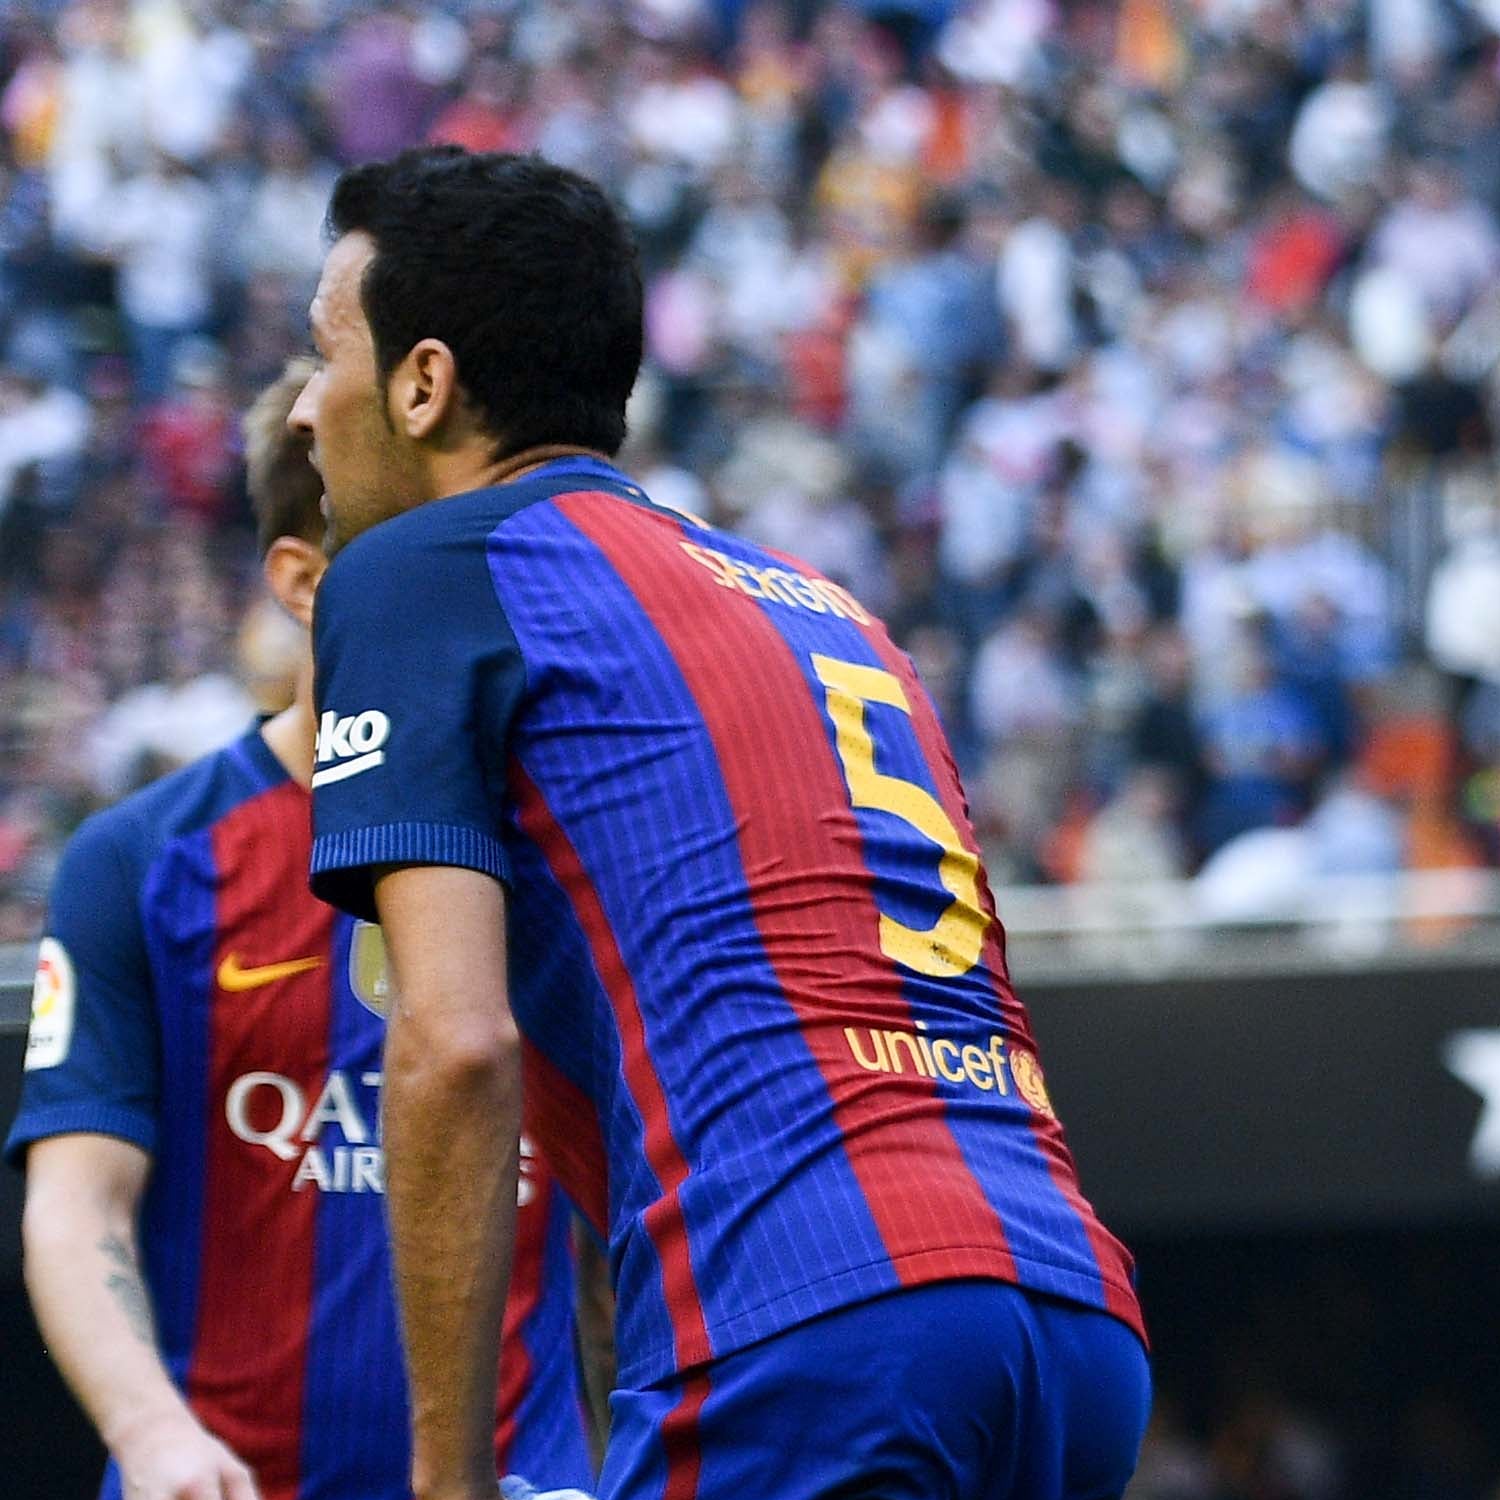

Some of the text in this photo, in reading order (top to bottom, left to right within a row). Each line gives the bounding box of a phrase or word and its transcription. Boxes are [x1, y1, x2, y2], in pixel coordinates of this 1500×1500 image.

[315, 709, 391, 764] ko
[811, 653, 992, 977] 5
[844, 1020, 1009, 1096] unicef
